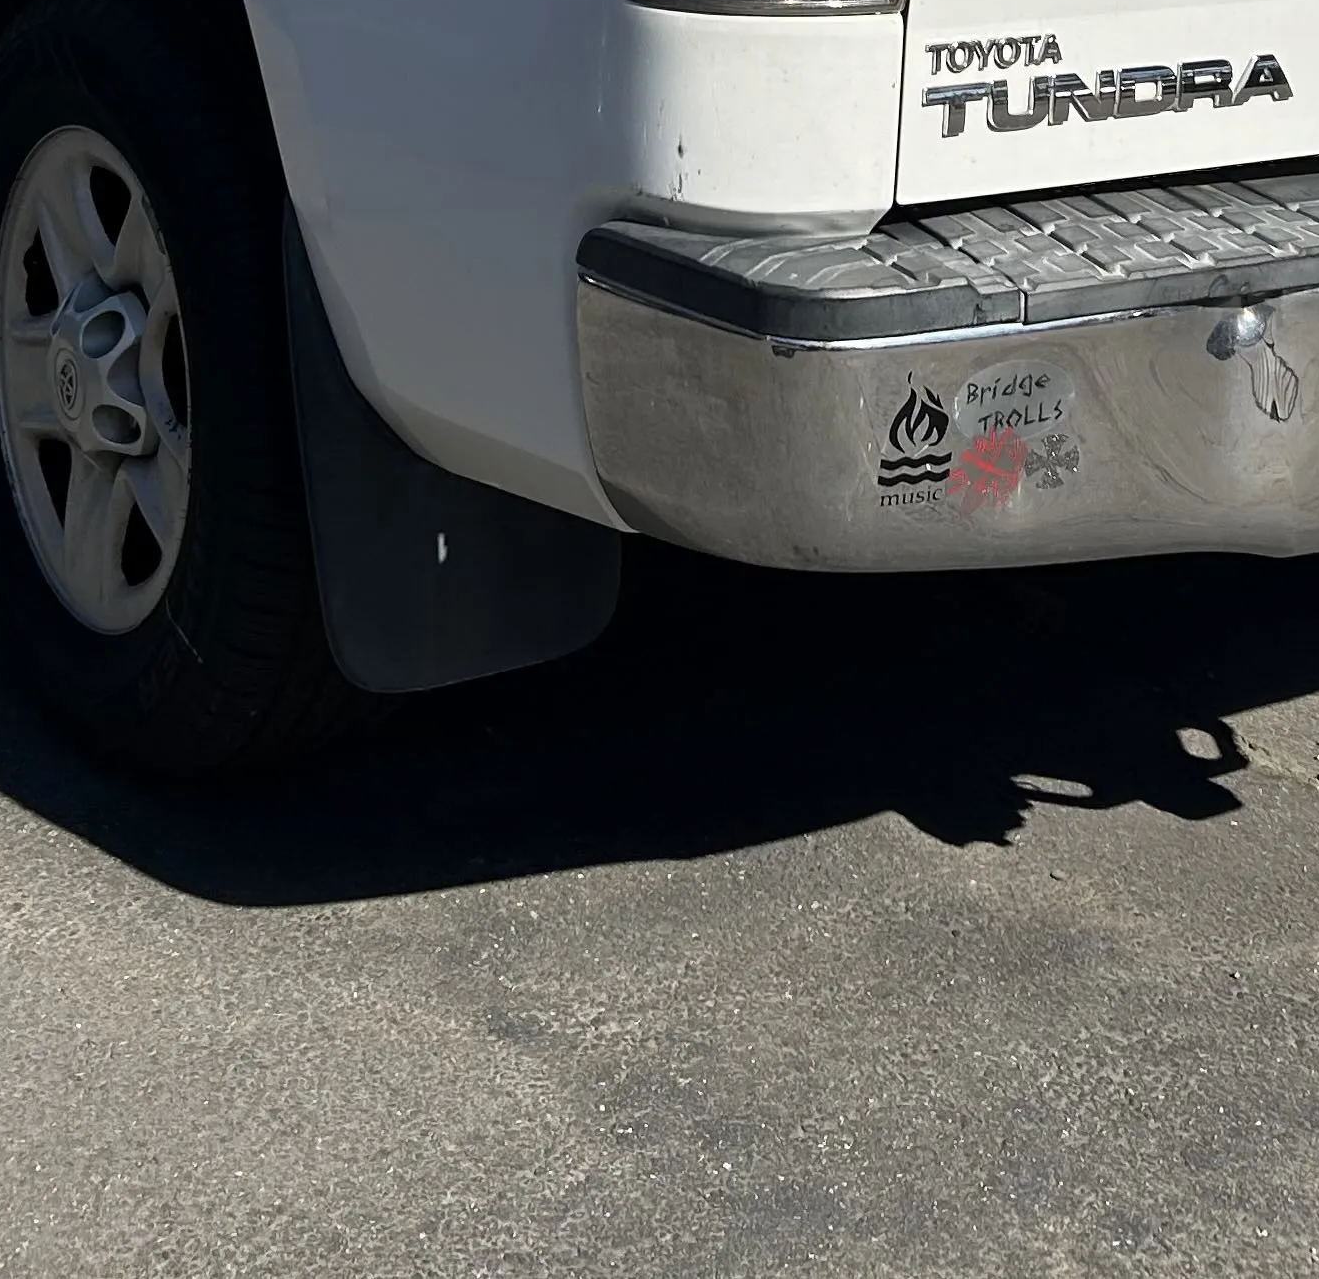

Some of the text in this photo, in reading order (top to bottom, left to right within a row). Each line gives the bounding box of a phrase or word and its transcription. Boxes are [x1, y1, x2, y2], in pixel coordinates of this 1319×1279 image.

[925, 33, 1063, 75] TOYOTA
[921, 53, 1294, 138] TUNDRA
[966, 373, 1051, 405] Bridge
[978, 399, 1063, 434] TROLLS
[880, 486, 943, 507] music
